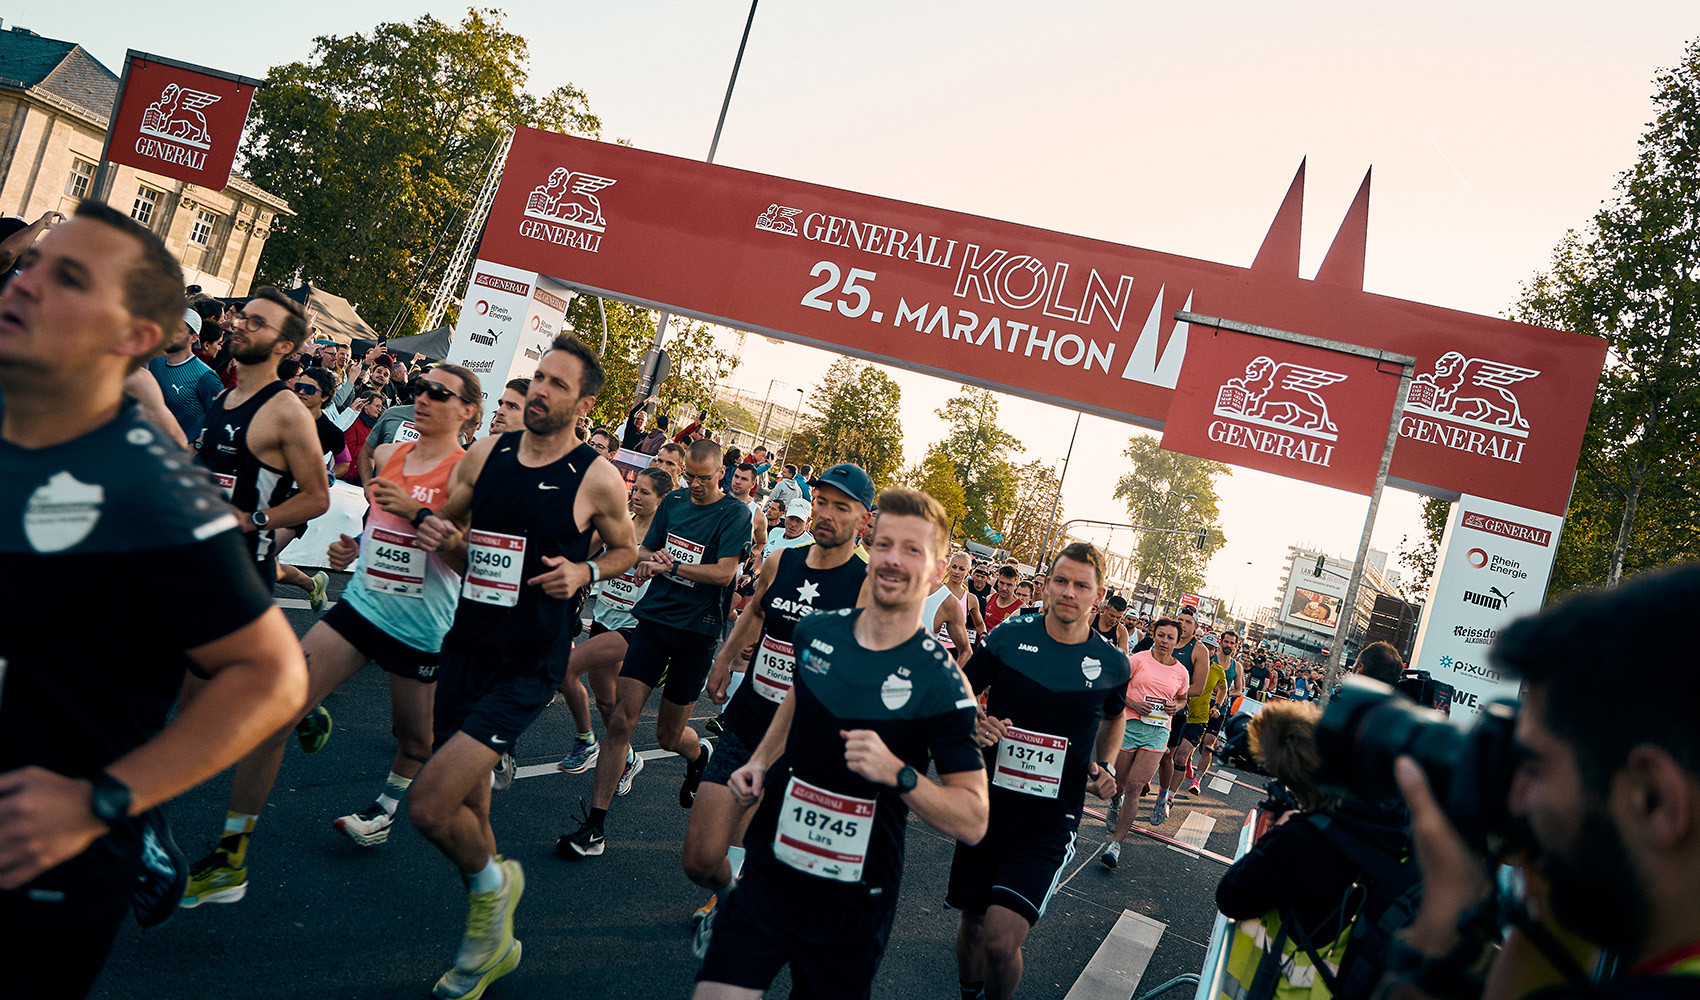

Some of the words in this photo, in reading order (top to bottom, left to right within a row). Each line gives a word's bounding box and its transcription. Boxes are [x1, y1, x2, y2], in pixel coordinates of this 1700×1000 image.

[135, 137, 208, 171] GENERALI
[519, 219, 603, 253] GENERALI
[803, 212, 958, 269] GENERALI
[953, 243, 1134, 332] KÖLN
[489, 278, 528, 295] GENERALI
[489, 310, 512, 323] Energie
[491, 304, 509, 315] Rhein
[800, 260, 884, 323] 25.
[893, 297, 1116, 375] MARATHON
[470, 332, 494, 347] PUMA
[1208, 420, 1335, 467] GENERALI
[1398, 416, 1526, 464] GENERALI
[1485, 519, 1548, 544] GENERALI
[375, 546, 411, 564] 4458
[470, 549, 512, 569] 15490
[667, 546, 694, 563] 14683
[1492, 554, 1520, 569] Rhein
[374, 560, 410, 573] Johannes
[472, 565, 502, 578] Raphael
[1490, 563, 1528, 580] Energie
[607, 579, 633, 593] 19620
[771, 597, 816, 617] SAYS
[1463, 590, 1501, 611] PUMA
[1453, 625, 1498, 639] Reissdo
[1018, 642, 1039, 653] JAKO
[1453, 660, 1500, 681] pixum
[1006, 744, 1055, 765] 13714
[1021, 761, 1036, 771] Tim
[793, 806, 858, 838] 18745
[808, 830, 832, 846] Lars
